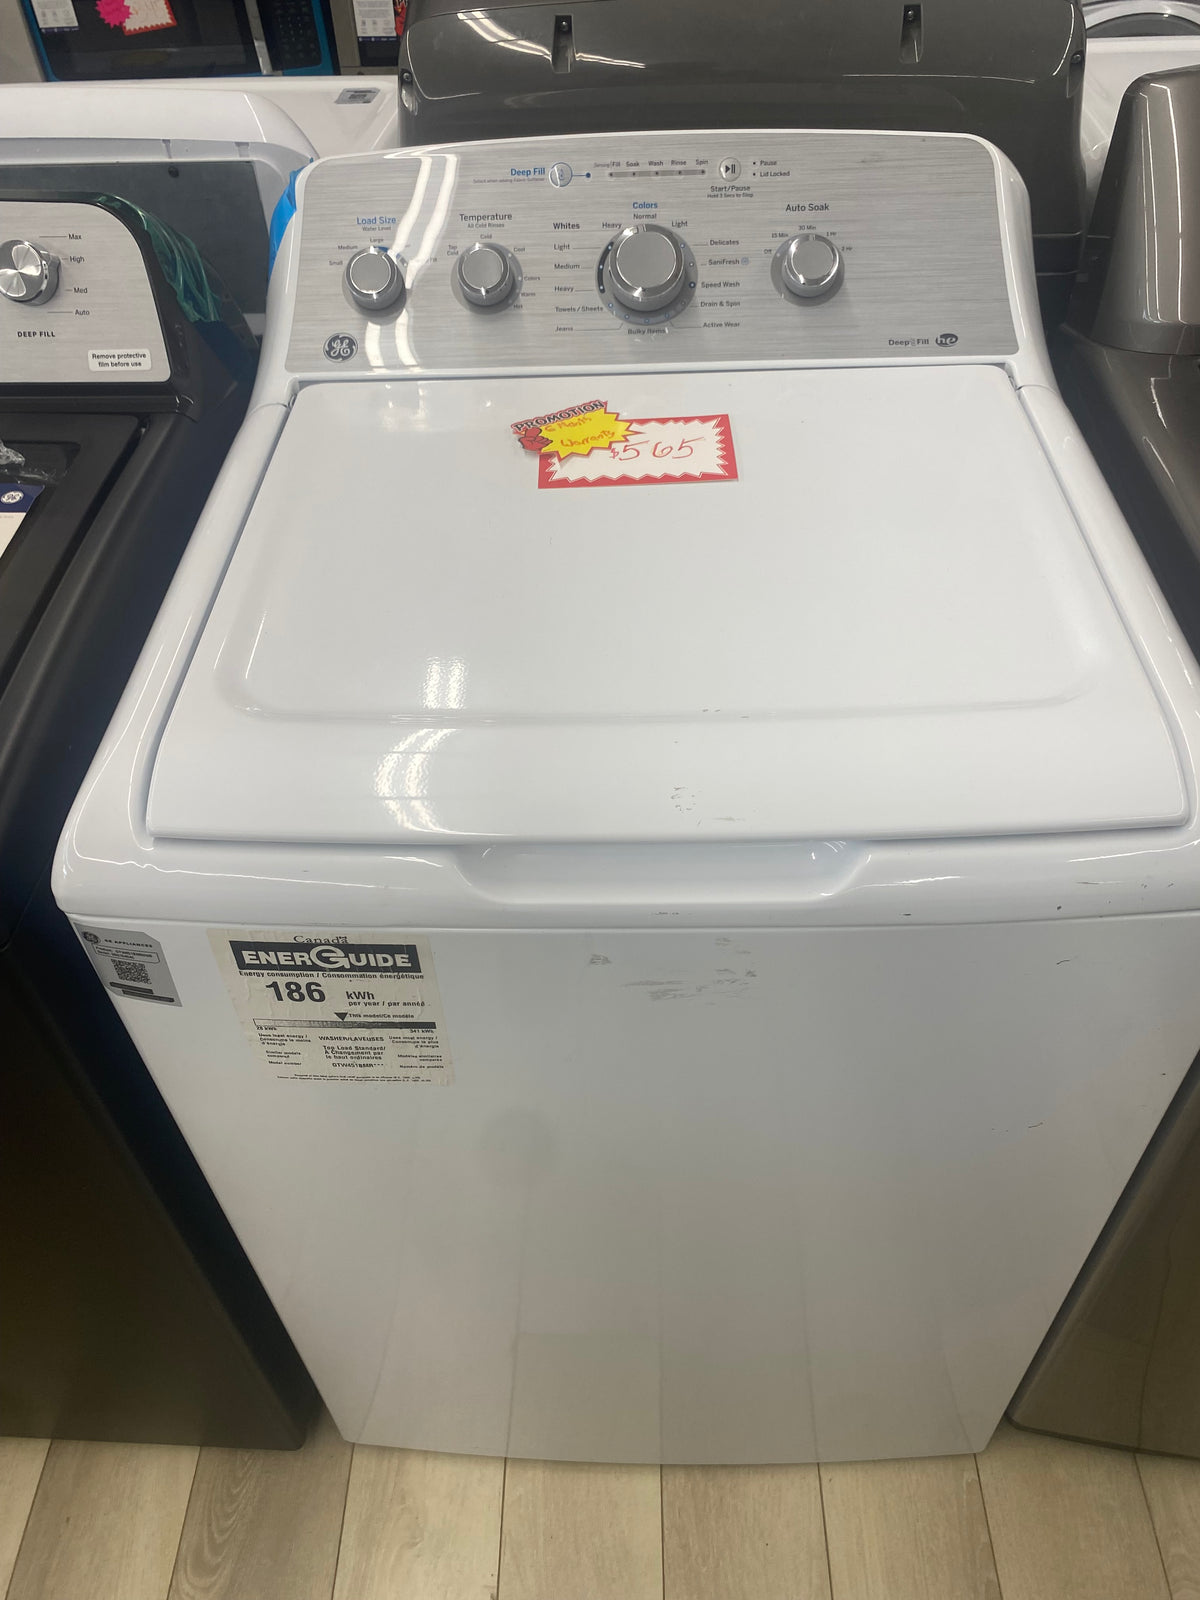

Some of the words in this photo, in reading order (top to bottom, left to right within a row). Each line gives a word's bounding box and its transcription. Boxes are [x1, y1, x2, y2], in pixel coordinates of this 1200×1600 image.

[626, 160, 640, 168] Soak
[510, 168, 532, 177] Deep
[533, 167, 546, 176] Fill
[786, 204, 806, 212] Auto
[808, 203, 830, 212] Soak
[356, 216, 377, 225] Load
[378, 216, 397, 224] Size
[459, 213, 512, 222] Temperature
[552, 222, 580, 230] Whites
[602, 222, 622, 230] Heavy
[553, 244, 570, 252] Light
[888, 339, 910, 347] Deep
[117, 352, 148, 360] protective
[513, 400, 605, 432] PROMOTION
[293, 936, 348, 944] Canada
[241, 944, 412, 969] ENERGUIDE
[379, 972, 424, 980] énergétique
[266, 981, 326, 1003] 186
[346, 990, 375, 1000] kWh
